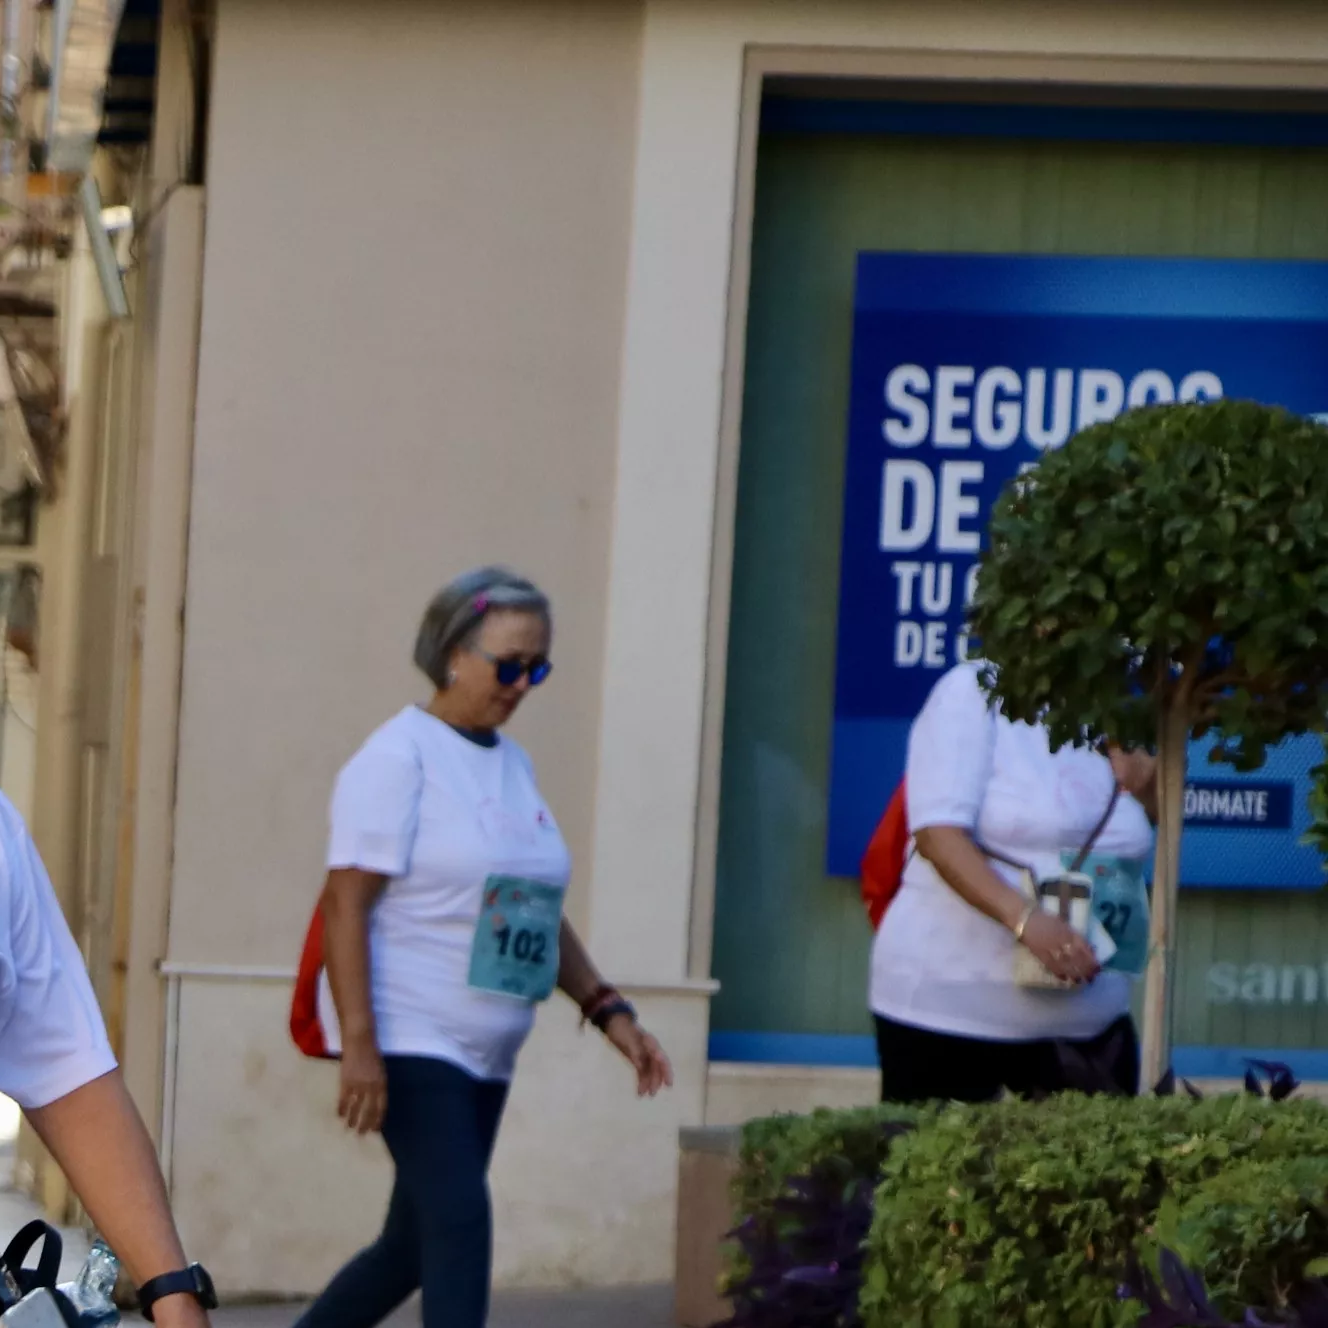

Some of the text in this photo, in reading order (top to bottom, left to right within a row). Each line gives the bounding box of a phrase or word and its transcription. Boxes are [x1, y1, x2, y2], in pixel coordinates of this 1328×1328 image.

[879, 458, 985, 554] DE
[890, 561, 953, 615] TU
[894, 622, 947, 668] DE
[1183, 784, 1269, 822] ÓRMATE
[494, 924, 546, 965] 102
[1205, 960, 1328, 1007] san
